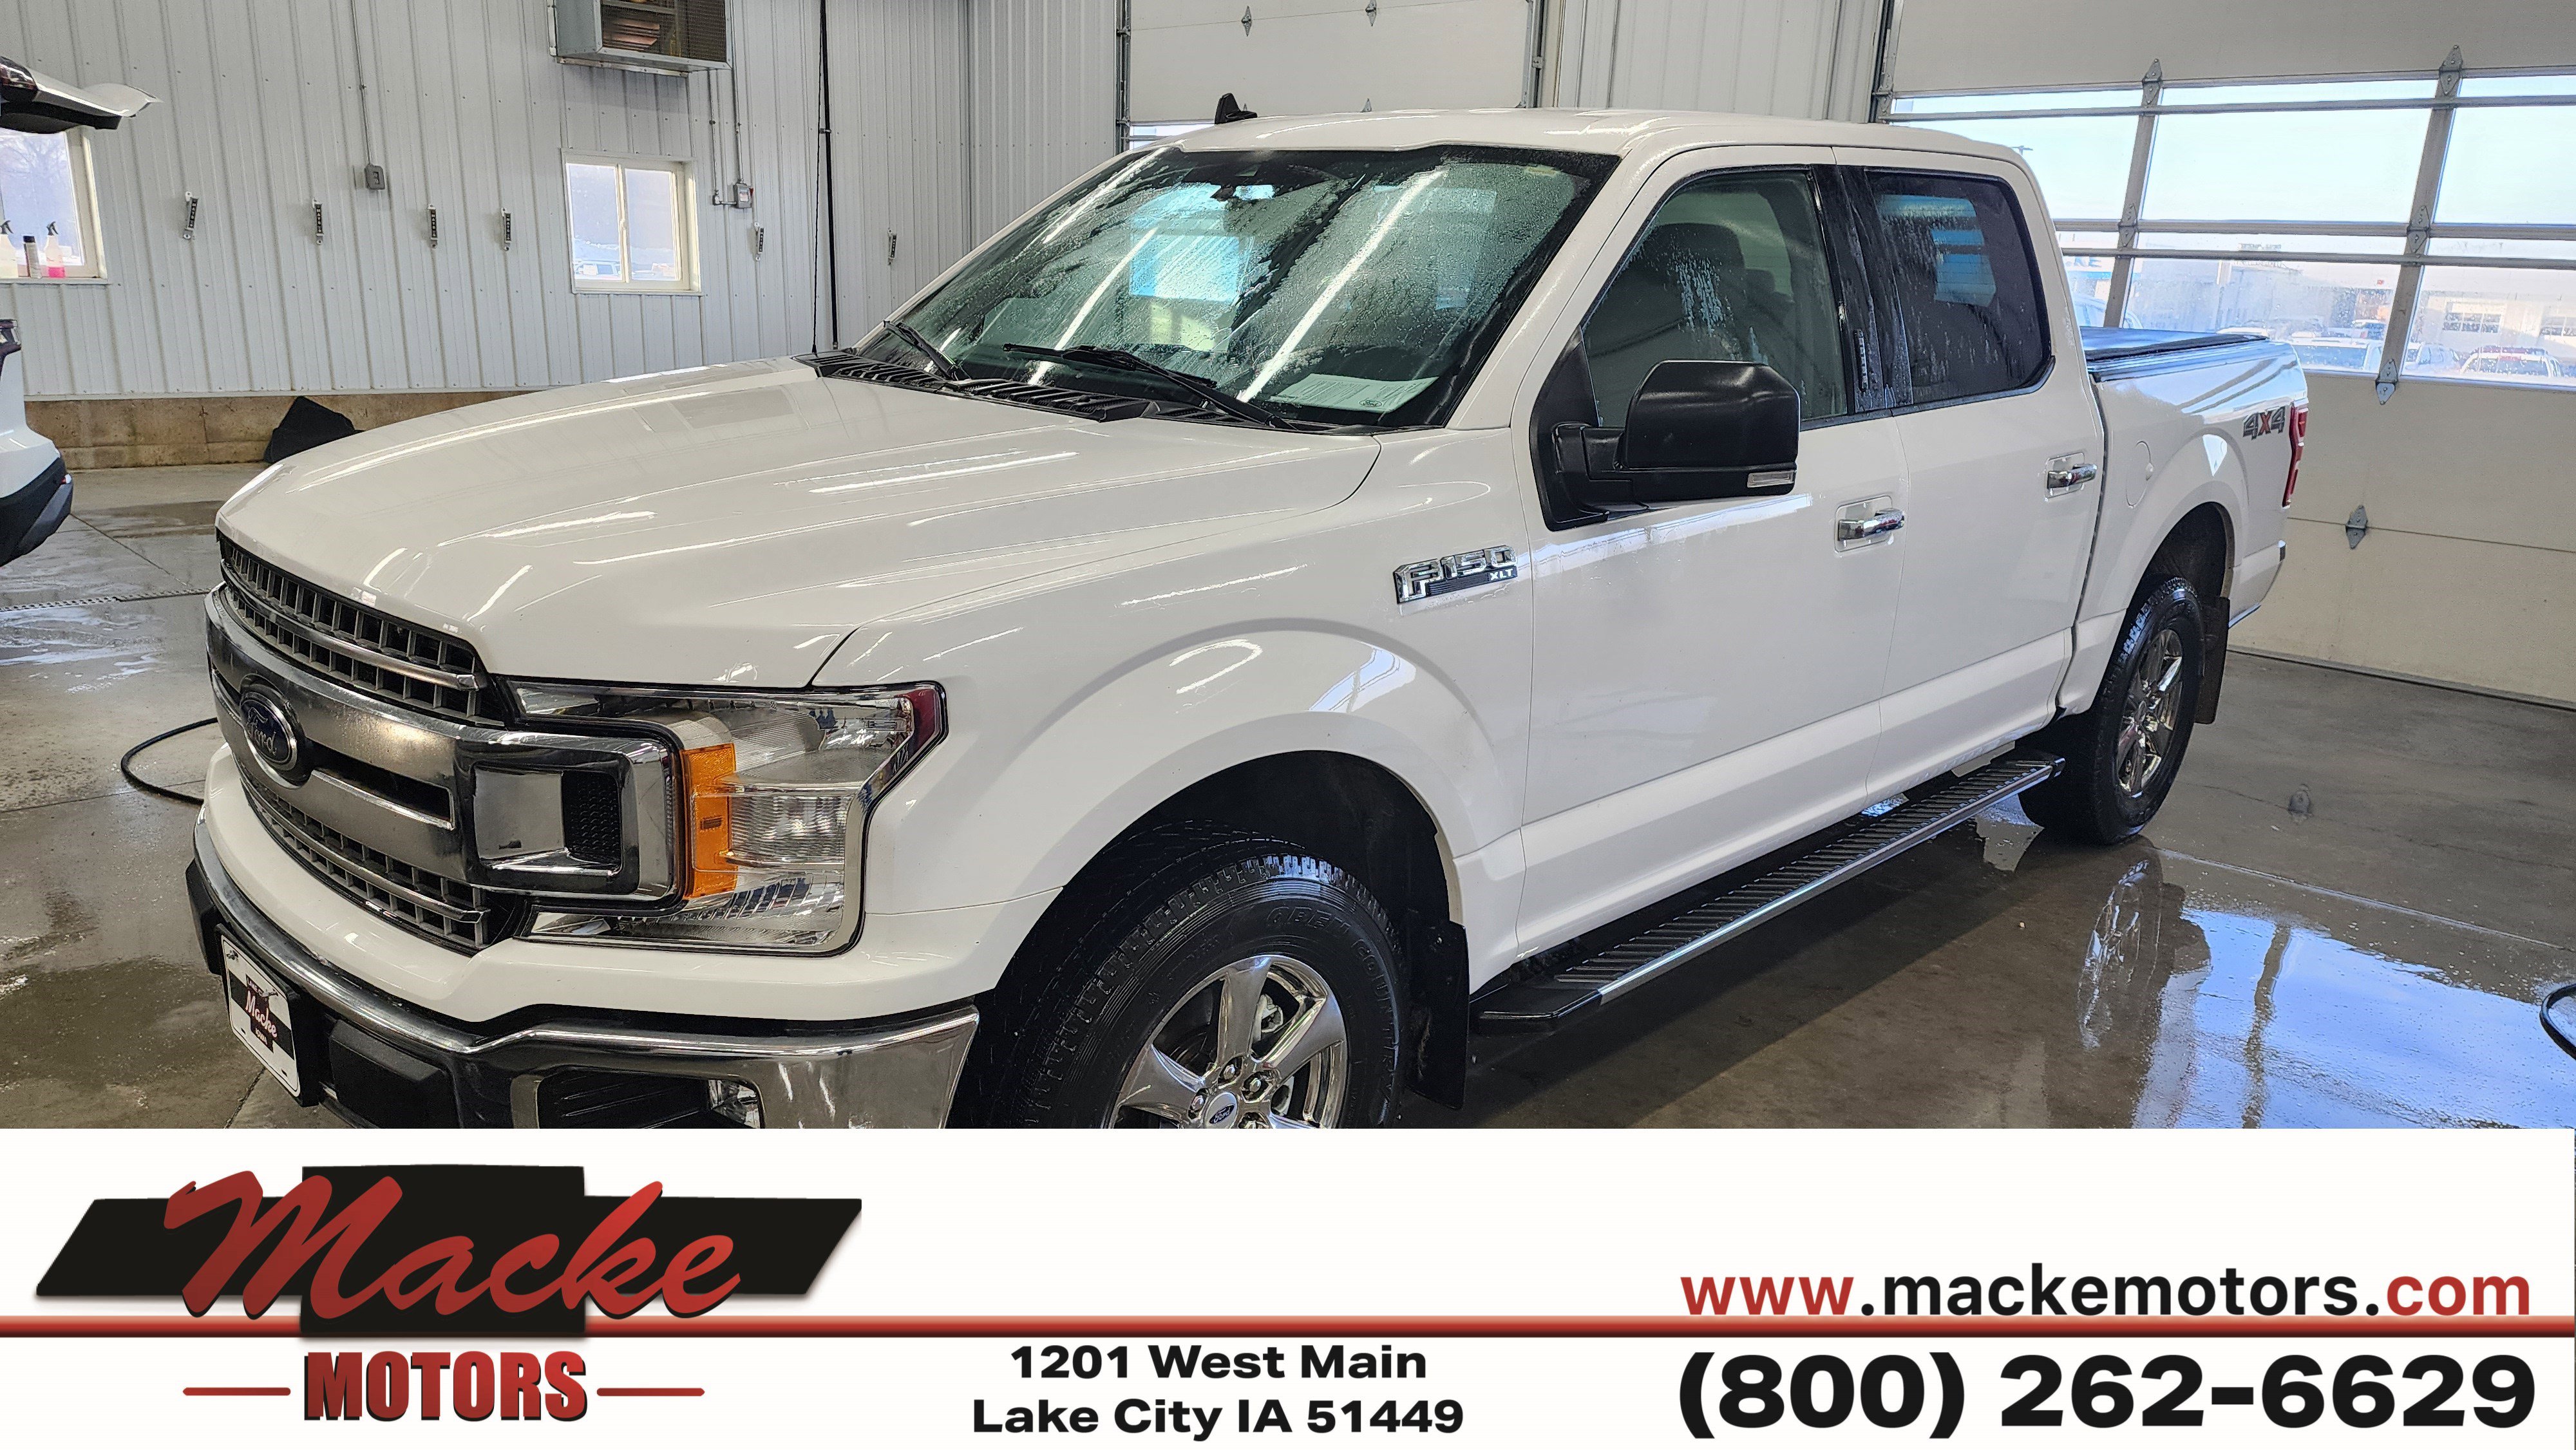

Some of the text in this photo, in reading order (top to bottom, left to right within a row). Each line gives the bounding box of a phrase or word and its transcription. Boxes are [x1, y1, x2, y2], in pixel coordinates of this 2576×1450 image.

[1490, 568, 1514, 581] XLT
[247, 707, 277, 756] Ford
[245, 990, 278, 1038] Macke
[1213, 1106, 1231, 1124] Ford
